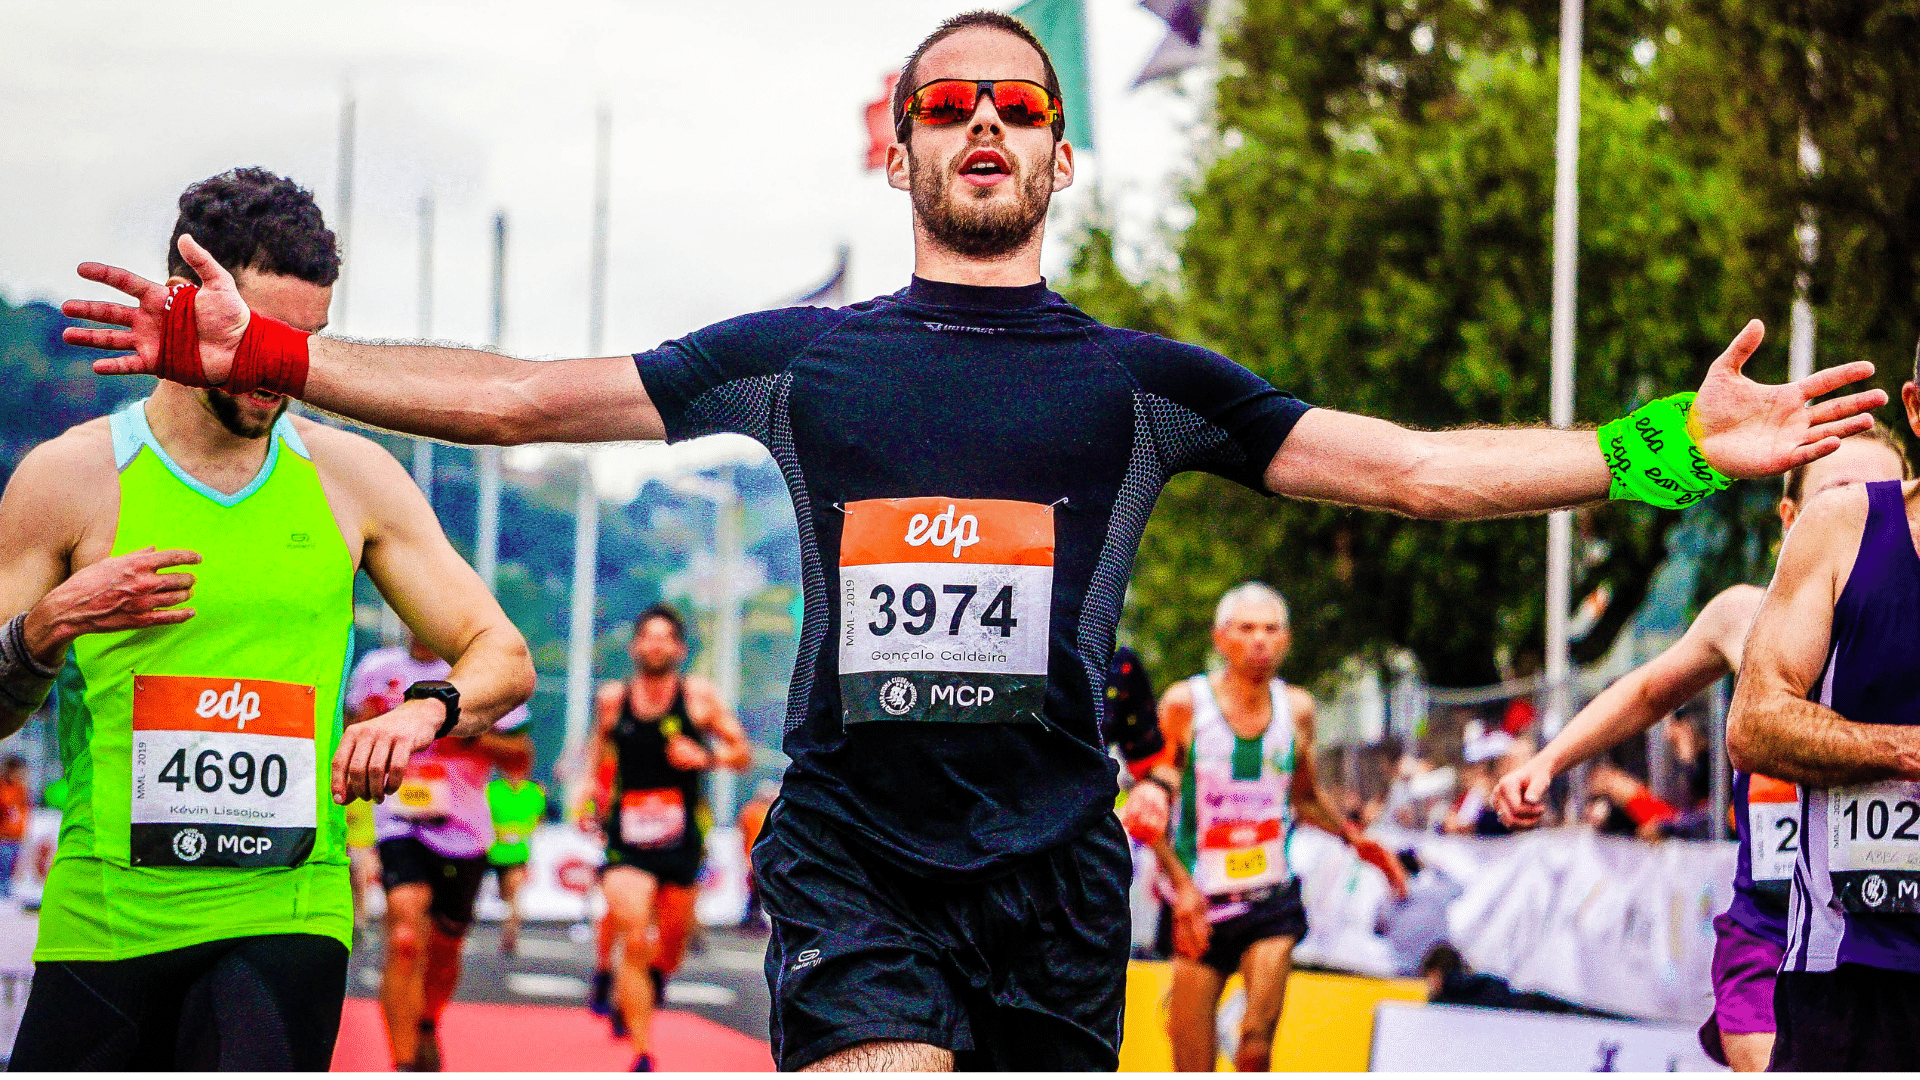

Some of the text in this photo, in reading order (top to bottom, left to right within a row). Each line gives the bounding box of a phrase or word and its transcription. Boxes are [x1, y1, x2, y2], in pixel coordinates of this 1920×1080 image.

[904, 504, 980, 558] edp
[846, 579, 855, 606] 2019
[868, 583, 1018, 638] 3974
[846, 617, 854, 646] MML
[871, 650, 1007, 663] Gonçalo Caldeira
[195, 682, 261, 730] edp
[930, 684, 994, 707] MCP
[137, 742, 147, 767] 2019
[158, 748, 288, 798] 4690
[137, 774, 146, 800] MML
[170, 805, 276, 819] Kévin Lissajoux
[1843, 799, 1920, 842] 102
[217, 834, 272, 855] MCP
